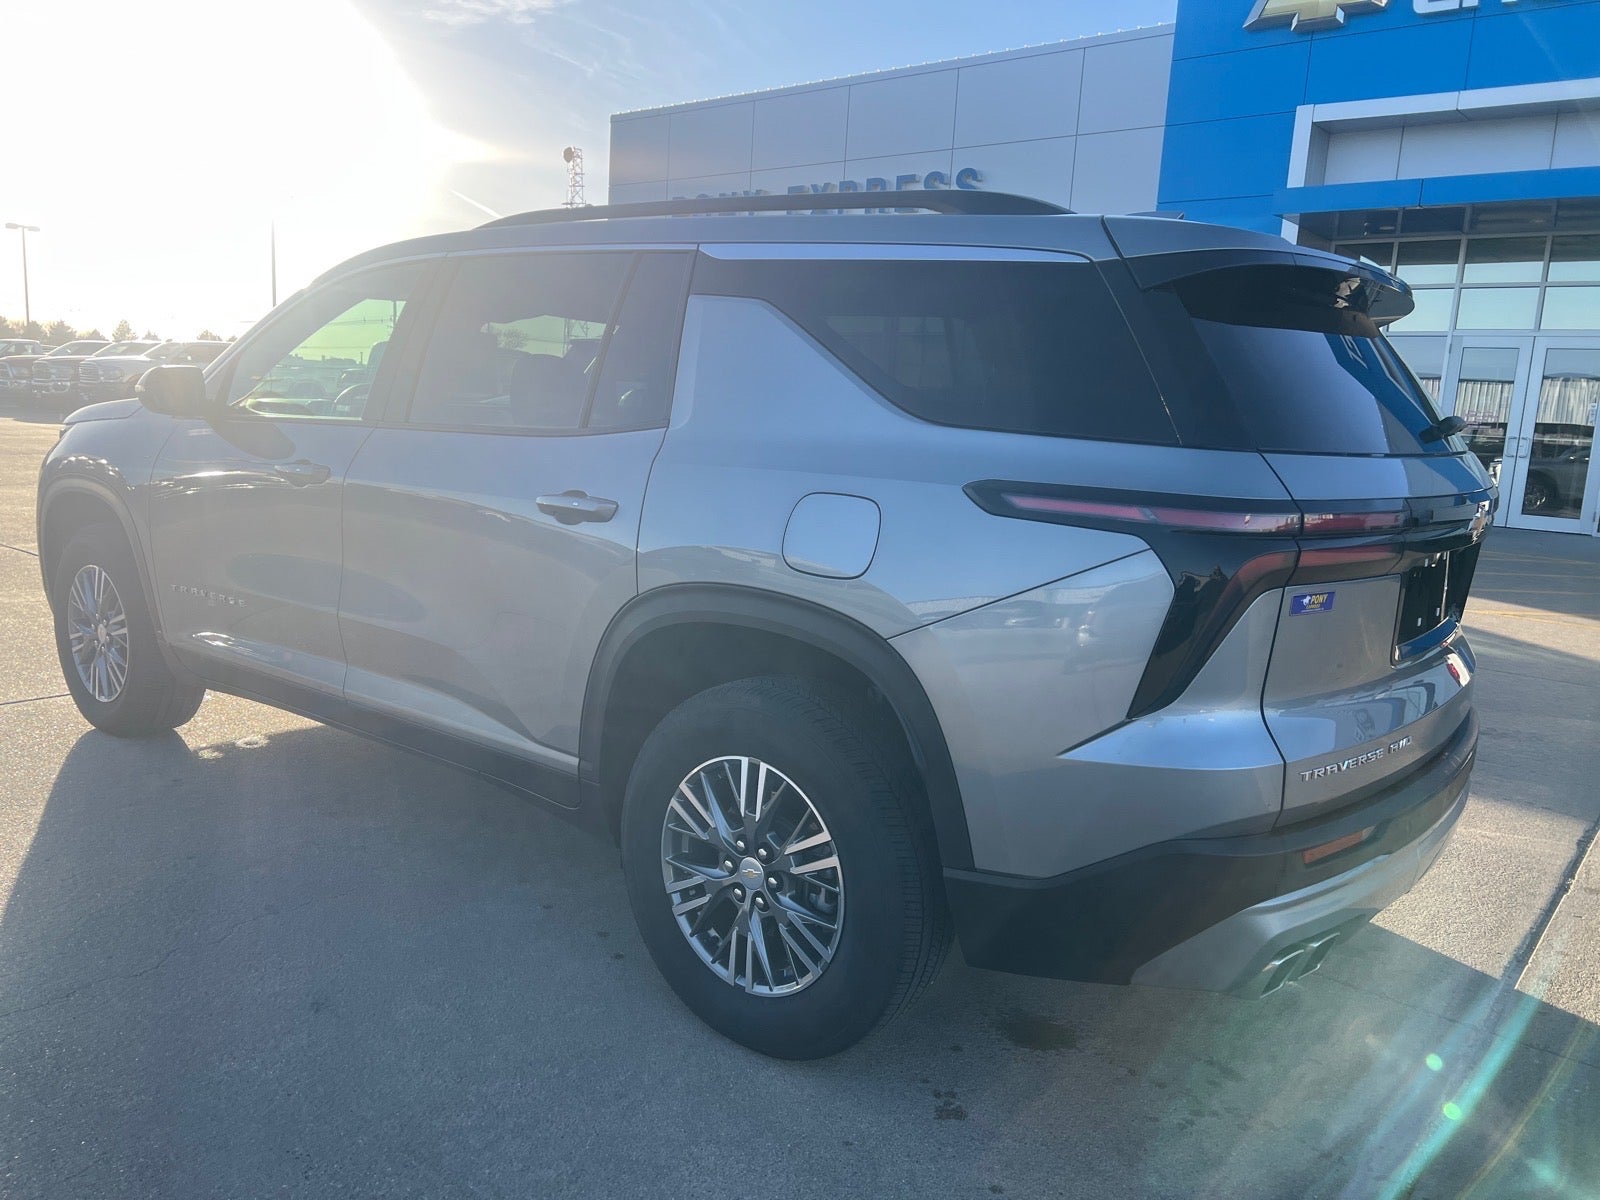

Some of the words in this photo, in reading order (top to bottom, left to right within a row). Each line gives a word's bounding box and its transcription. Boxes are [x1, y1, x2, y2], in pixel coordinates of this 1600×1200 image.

[1310, 593, 1329, 604] PONY
[1300, 747, 1384, 782] TRAVERSE
[1388, 735, 1413, 754] AWD
